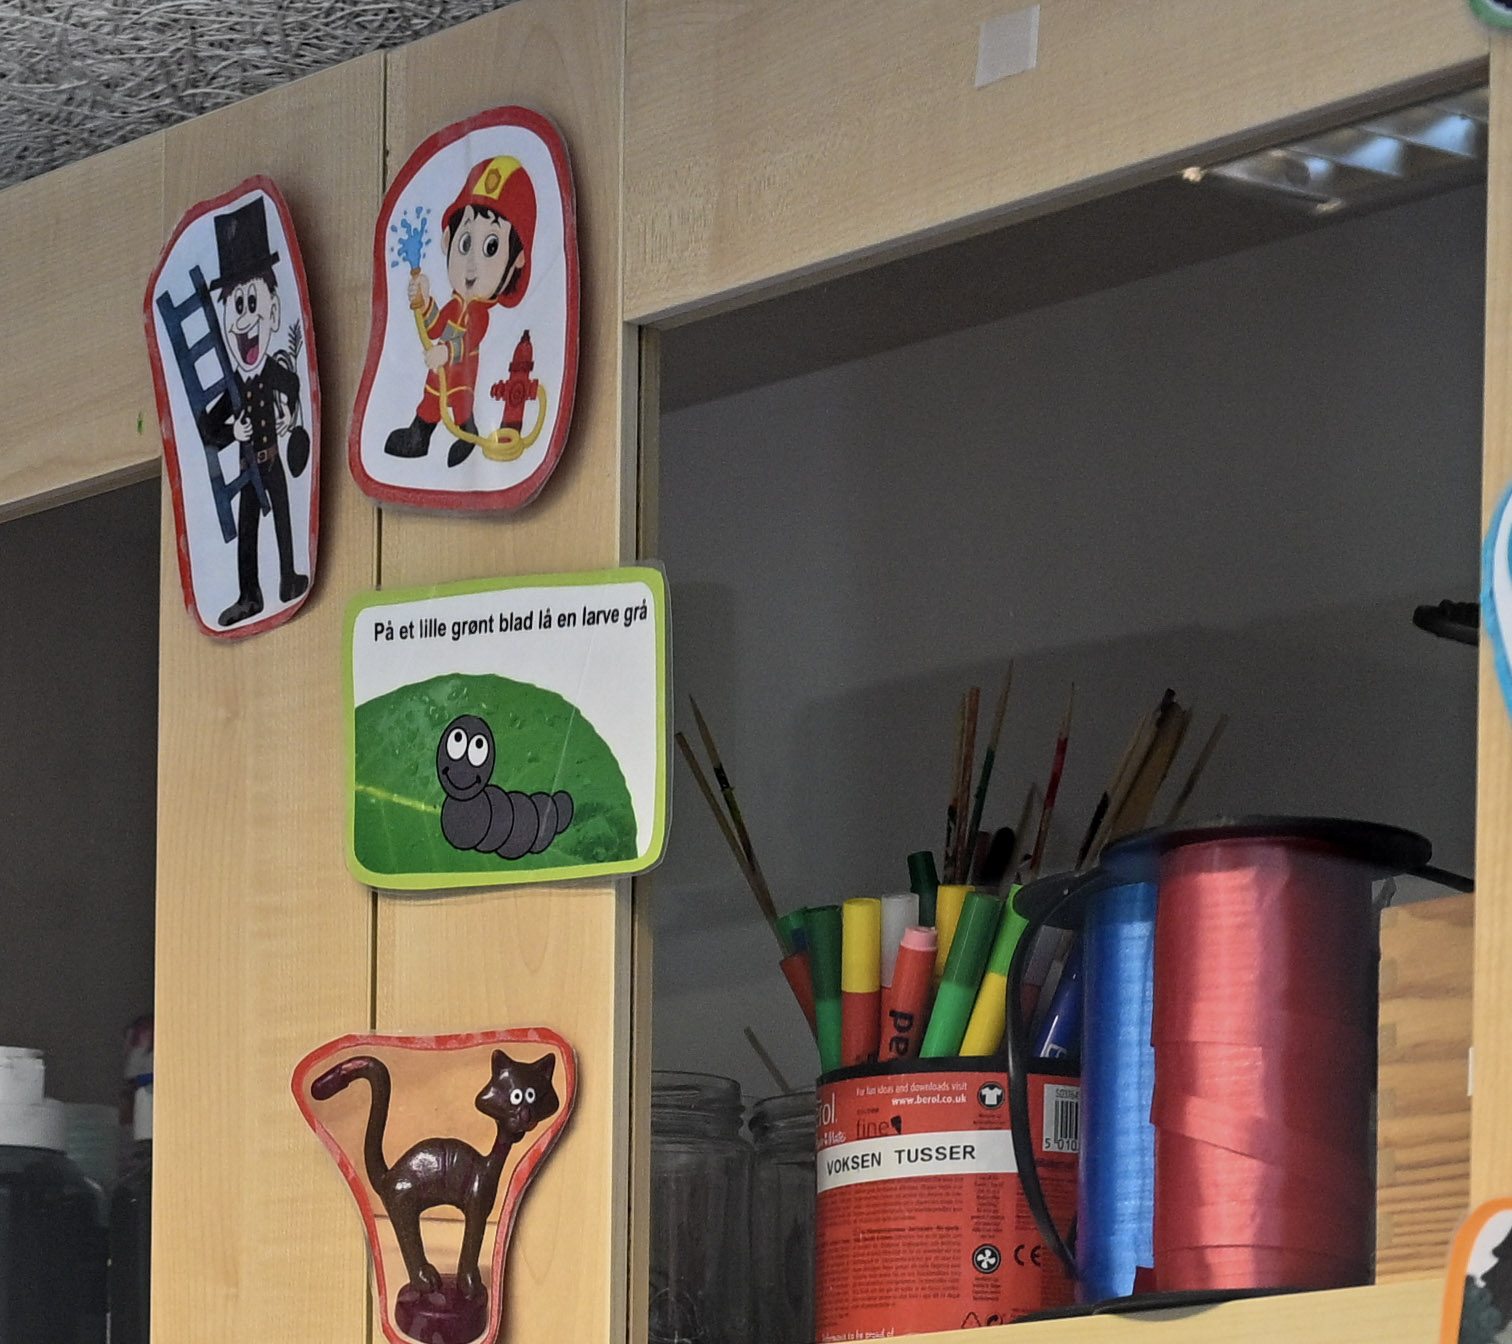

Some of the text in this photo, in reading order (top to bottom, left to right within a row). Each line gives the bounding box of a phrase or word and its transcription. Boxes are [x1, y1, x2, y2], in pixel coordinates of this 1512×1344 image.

[374, 598, 648, 642] På et lille grønt blad lå en larve grå
[910, 1080, 949, 1092] downloads
[952, 1081, 968, 1091] visit
[891, 1093, 967, 1106] www.berol.co.uk
[827, 1144, 977, 1177] VOKSEN TUSSER
